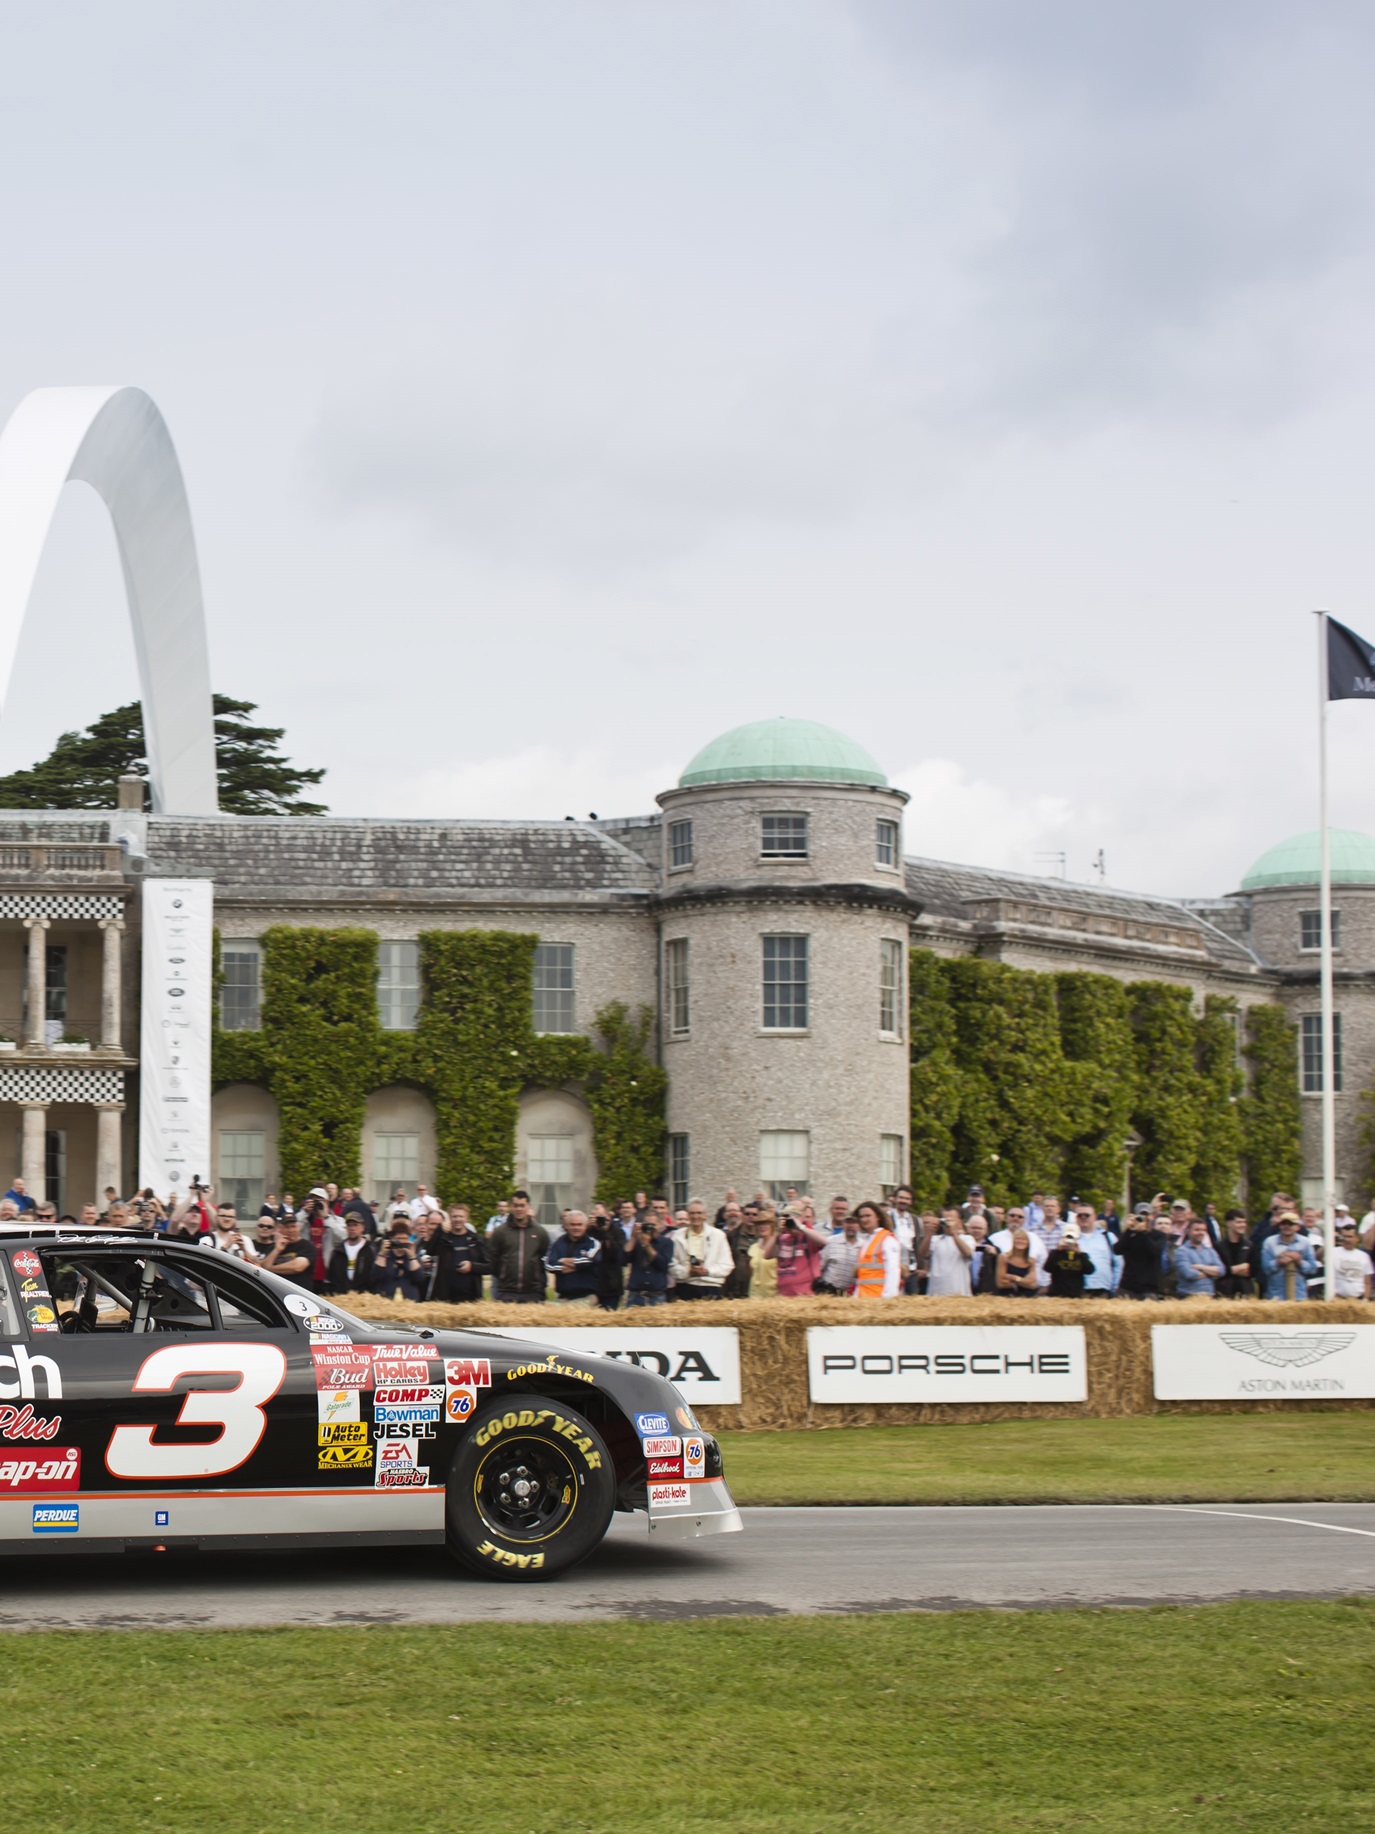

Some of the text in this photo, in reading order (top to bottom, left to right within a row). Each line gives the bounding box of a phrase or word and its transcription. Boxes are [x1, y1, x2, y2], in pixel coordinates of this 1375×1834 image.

[298, 1301, 308, 1312] 3
[310, 1321, 338, 1330] 2000
[326, 1345, 354, 1353] NASCAR
[314, 1352, 371, 1365] Winston Cup
[822, 1354, 1070, 1375] PORSCHE
[329, 1367, 369, 1384] Bud
[374, 1361, 428, 1383] Holley
[447, 1360, 490, 1386] 3M
[1238, 1379, 1345, 1392] ASTON MARTIN
[375, 1388, 430, 1403] COMP
[104, 1341, 288, 1480] 3
[450, 1397, 471, 1415] 76
[375, 1407, 439, 1422] Bowman
[334, 1424, 361, 1433] Auto
[638, 1415, 668, 1430] CLEVITE
[331, 1433, 366, 1442] Meter
[374, 1422, 436, 1439] JESEL
[646, 1440, 677, 1454] SIMPSON
[688, 1444, 702, 1459] 76
[318, 1460, 373, 1470] MECHANIX WEAR
[380, 1460, 413, 1469] SPORTS
[649, 1462, 681, 1475] Edelbrock
[377, 1472, 428, 1487] Sports
[651, 1486, 687, 1501] plasti-kote
[33, 1509, 78, 1522] PERDUE
[476, 1539, 546, 1569] EAGLE
